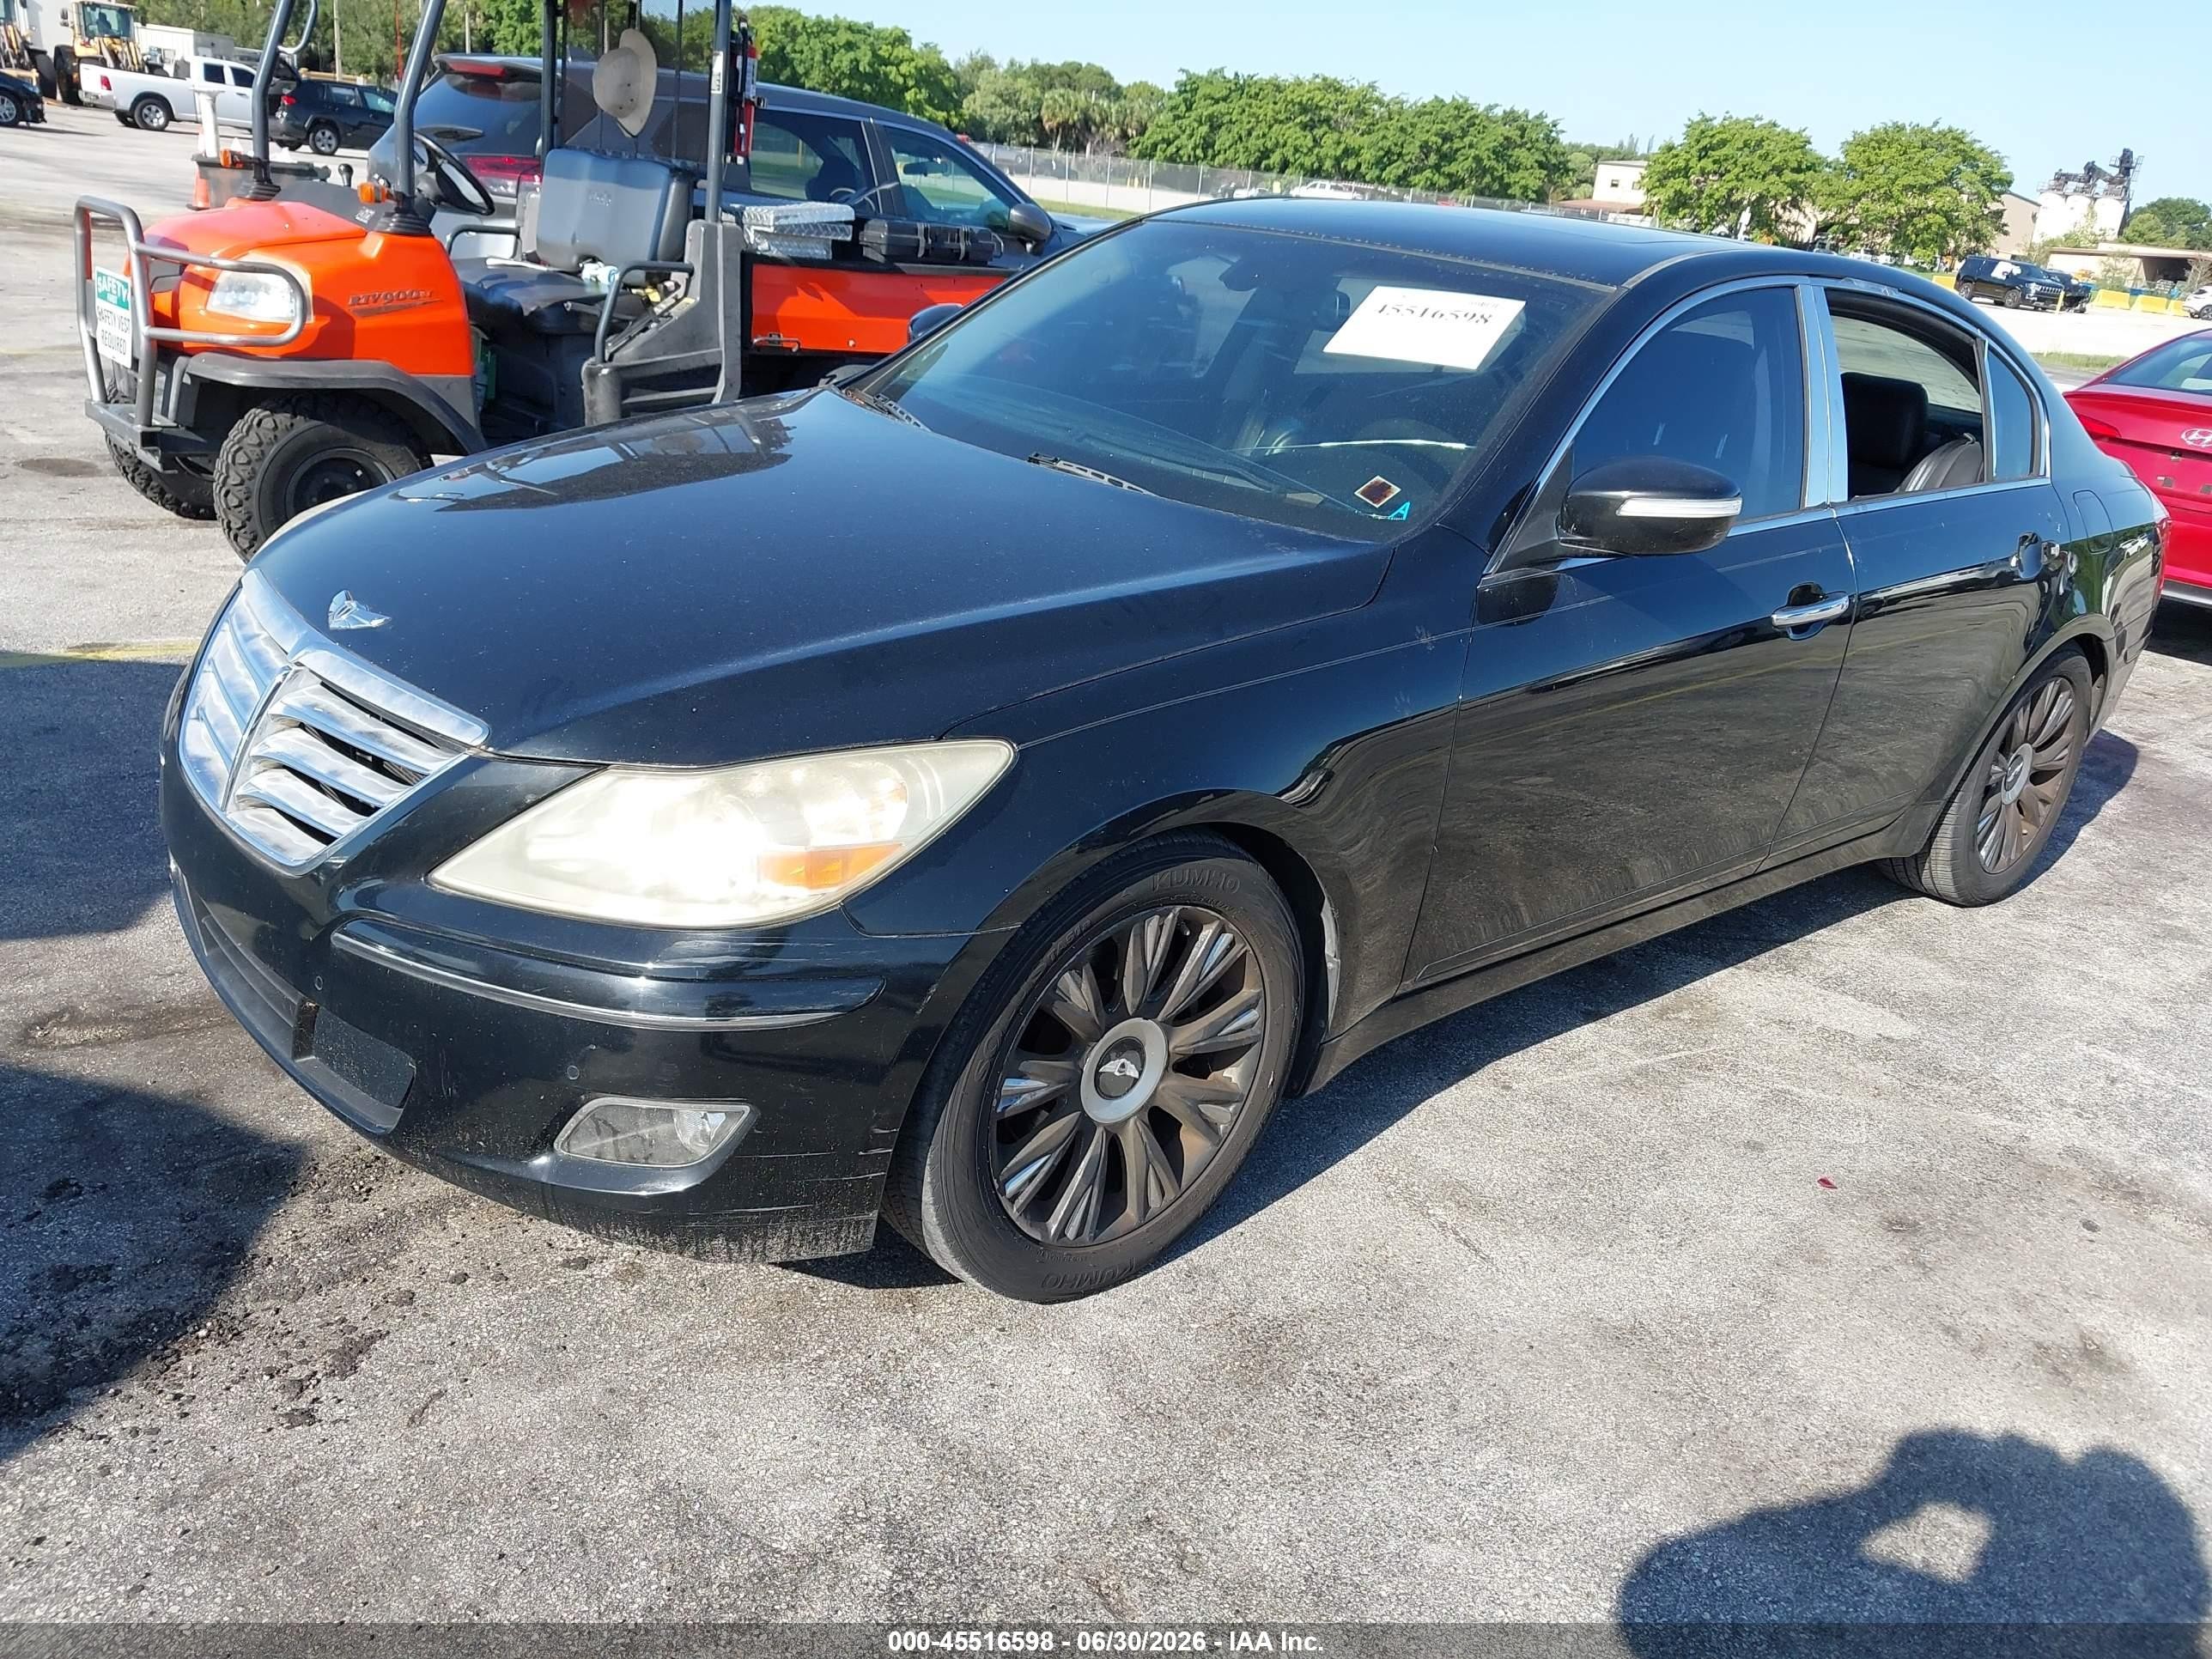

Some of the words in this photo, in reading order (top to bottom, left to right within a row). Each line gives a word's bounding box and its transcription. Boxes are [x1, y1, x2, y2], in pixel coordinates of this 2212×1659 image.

[97, 276, 129, 303] SAFETY
[96, 306, 117, 328] SAFETY
[101, 330, 127, 355] REQUIRED
[1152, 867, 1241, 894] KUMHO
[1041, 1256, 1137, 1289] KUMHO
